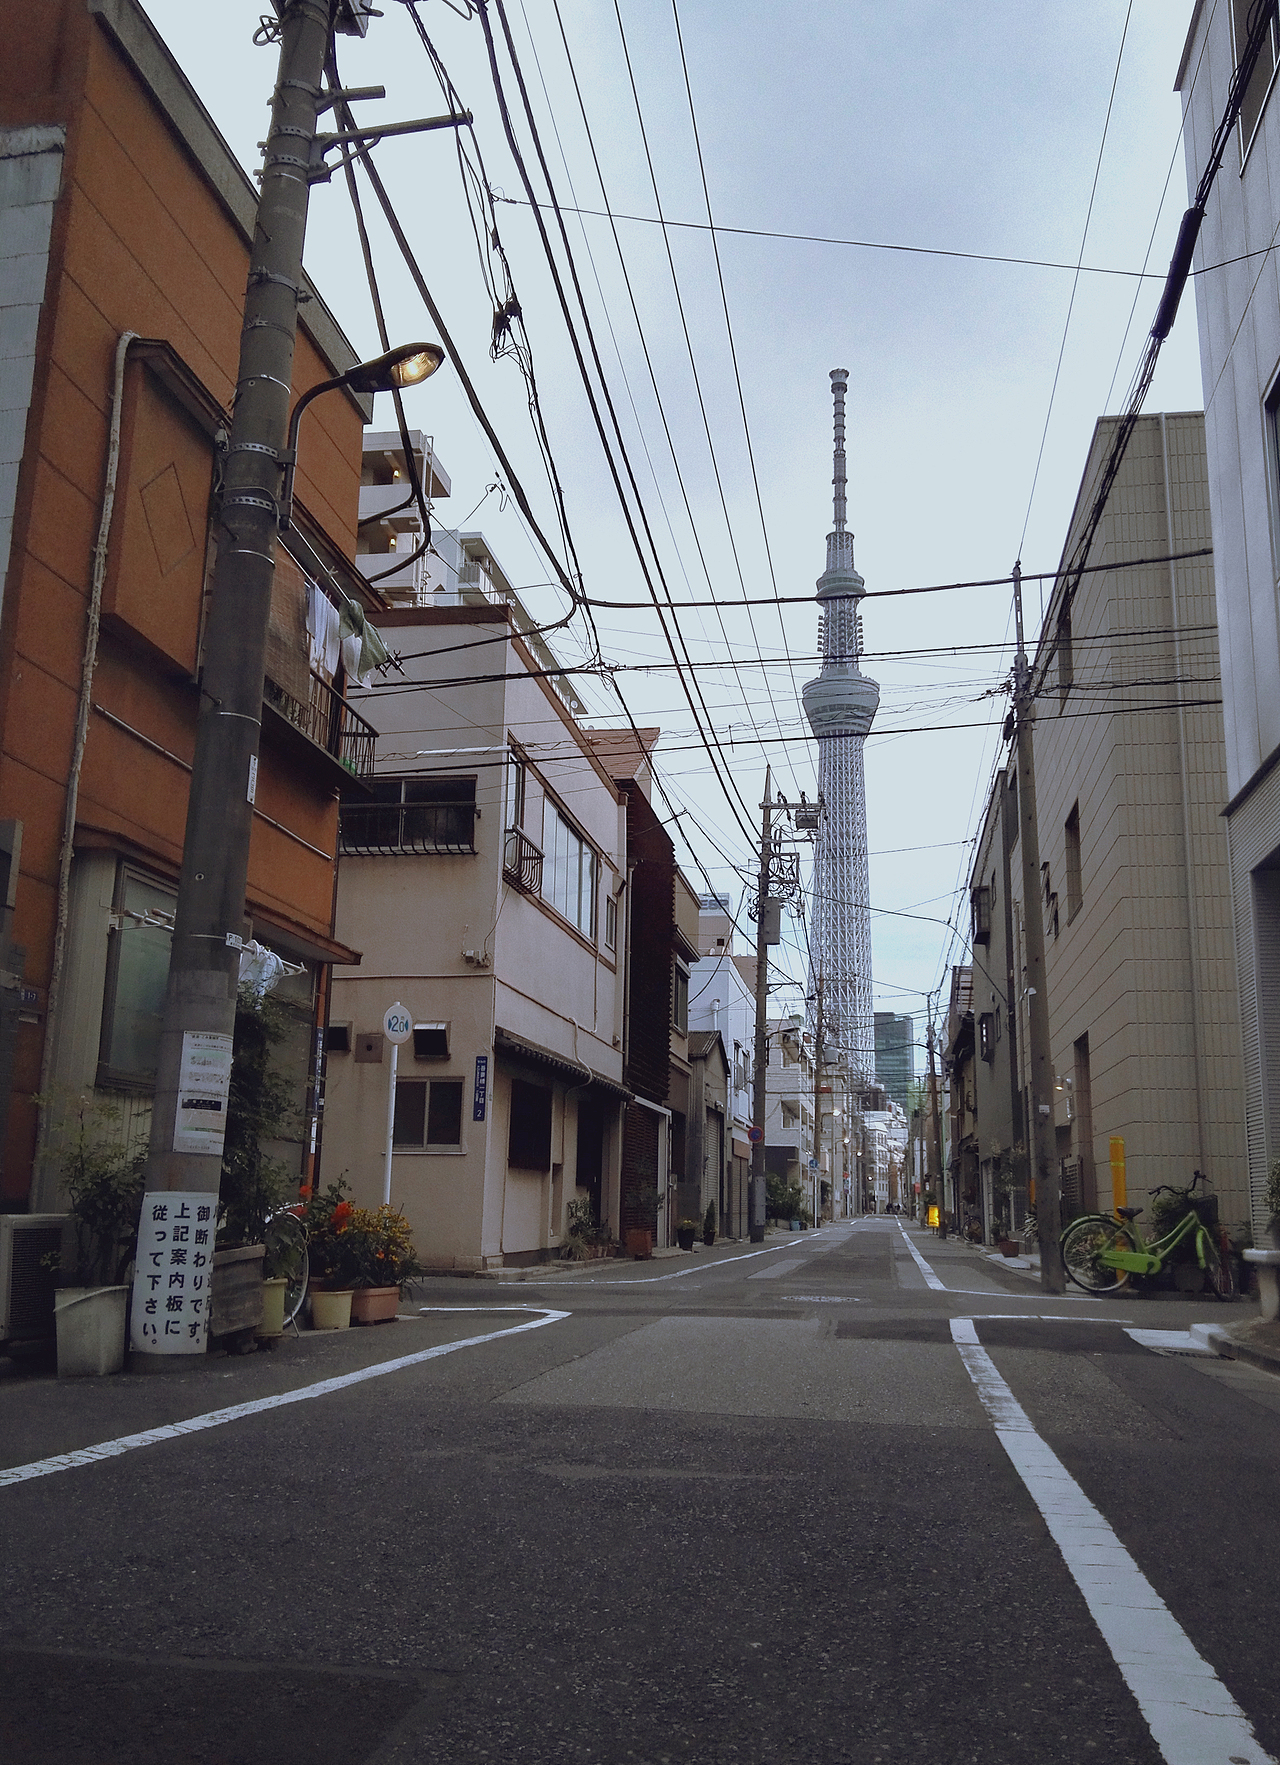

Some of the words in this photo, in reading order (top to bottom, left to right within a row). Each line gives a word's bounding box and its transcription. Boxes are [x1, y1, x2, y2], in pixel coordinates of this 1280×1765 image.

[476, 1109, 482, 1118] 2
[143, 1204, 168, 1345] 従って下さい。
[165, 1202, 190, 1335] 上記案内板に
[188, 1205, 211, 1344] 御断わりです。
